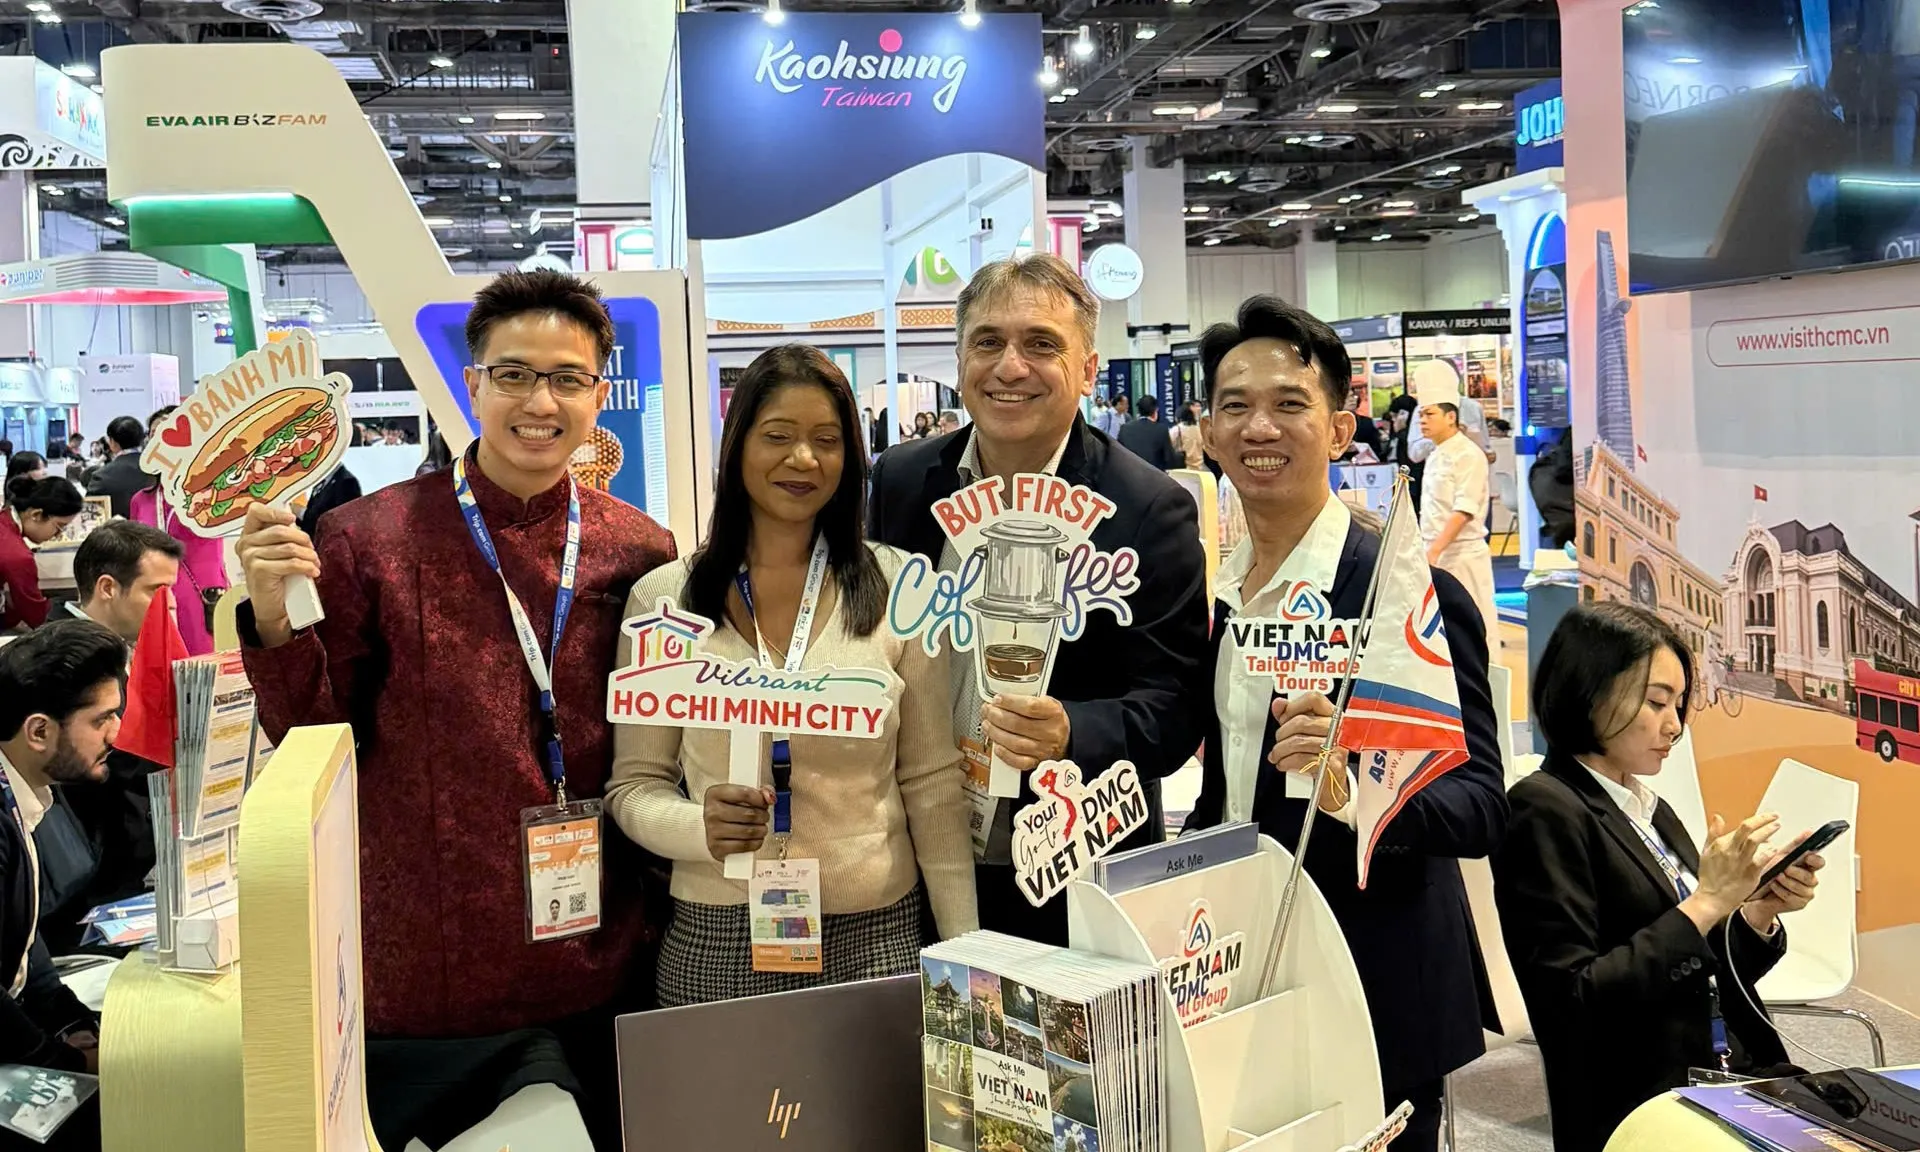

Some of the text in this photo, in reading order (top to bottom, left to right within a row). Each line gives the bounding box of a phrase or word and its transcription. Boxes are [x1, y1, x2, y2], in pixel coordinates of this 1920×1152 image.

[755, 28, 967, 113] Kaohsiung
[821, 86, 912, 107] Taiwan
[1408, 319, 1447, 330] KAVAYA
[1455, 318, 1479, 329] REPS
[1736, 326, 1890, 351] www.visithcmc.vn
[190, 358, 265, 433] BÁNH
[1164, 369, 1175, 423] STARTUP
[935, 477, 1112, 537] BUT FIRST
[1246, 655, 1360, 674] Tailor-made
[1277, 640, 1328, 662] DMC
[696, 660, 885, 692] Vibrant
[1276, 674, 1328, 691] Tours
[613, 689, 883, 733] HO CHI MINH CITY
[1081, 768, 1136, 825] DMC
[1023, 801, 1058, 834] Your
[1083, 791, 1145, 858] NAM
[1166, 853, 1204, 873] Ask Me
[1195, 940, 1242, 979] NAM
[1176, 973, 1210, 1008] DMC
[1192, 986, 1228, 1013] Group
[999, 1060, 1012, 1072] Ask
[1013, 1082, 1048, 1111] NAM
[768, 1088, 801, 1139] hp
